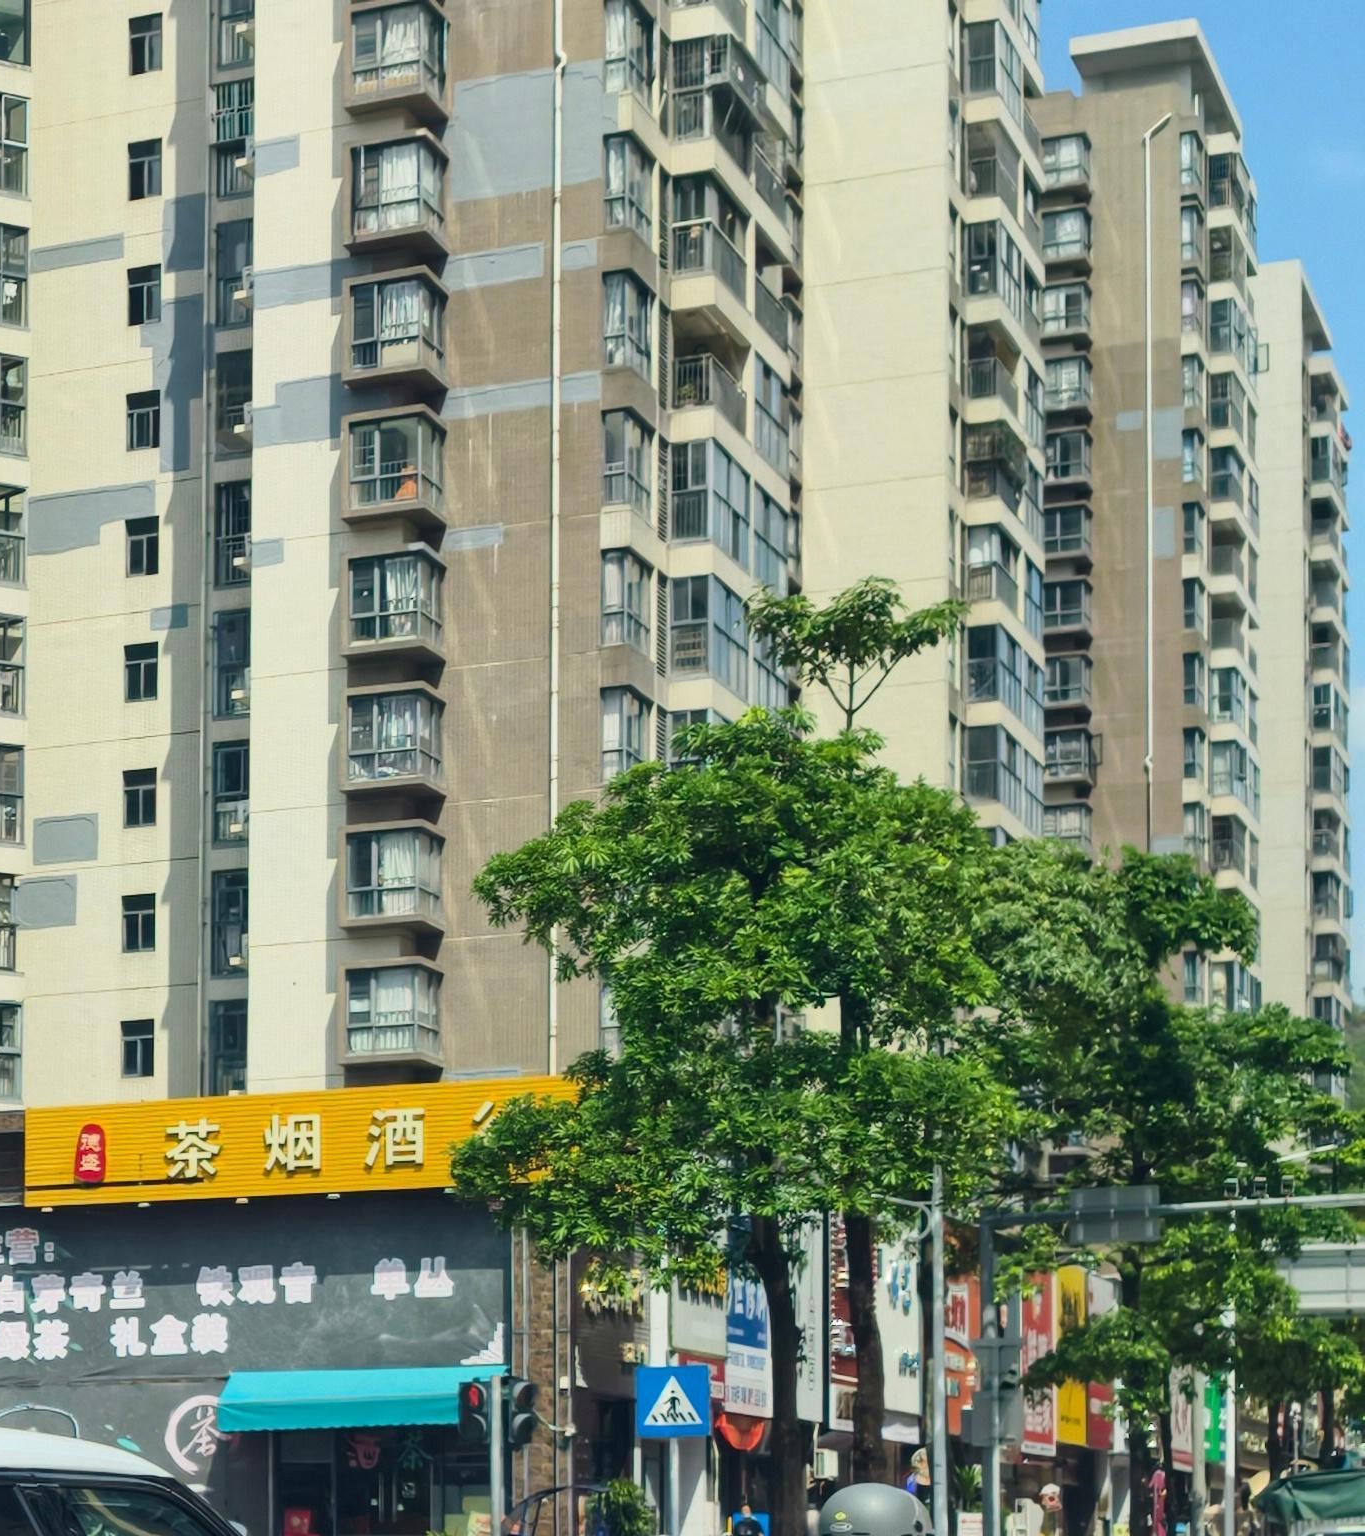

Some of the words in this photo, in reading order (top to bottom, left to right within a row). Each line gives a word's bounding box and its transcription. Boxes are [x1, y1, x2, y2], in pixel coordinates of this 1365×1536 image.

[165, 1101, 495, 1179] 茶烟酒
[196, 1261, 317, 1308] 铁观音
[110, 1313, 228, 1358] 礼盒装
